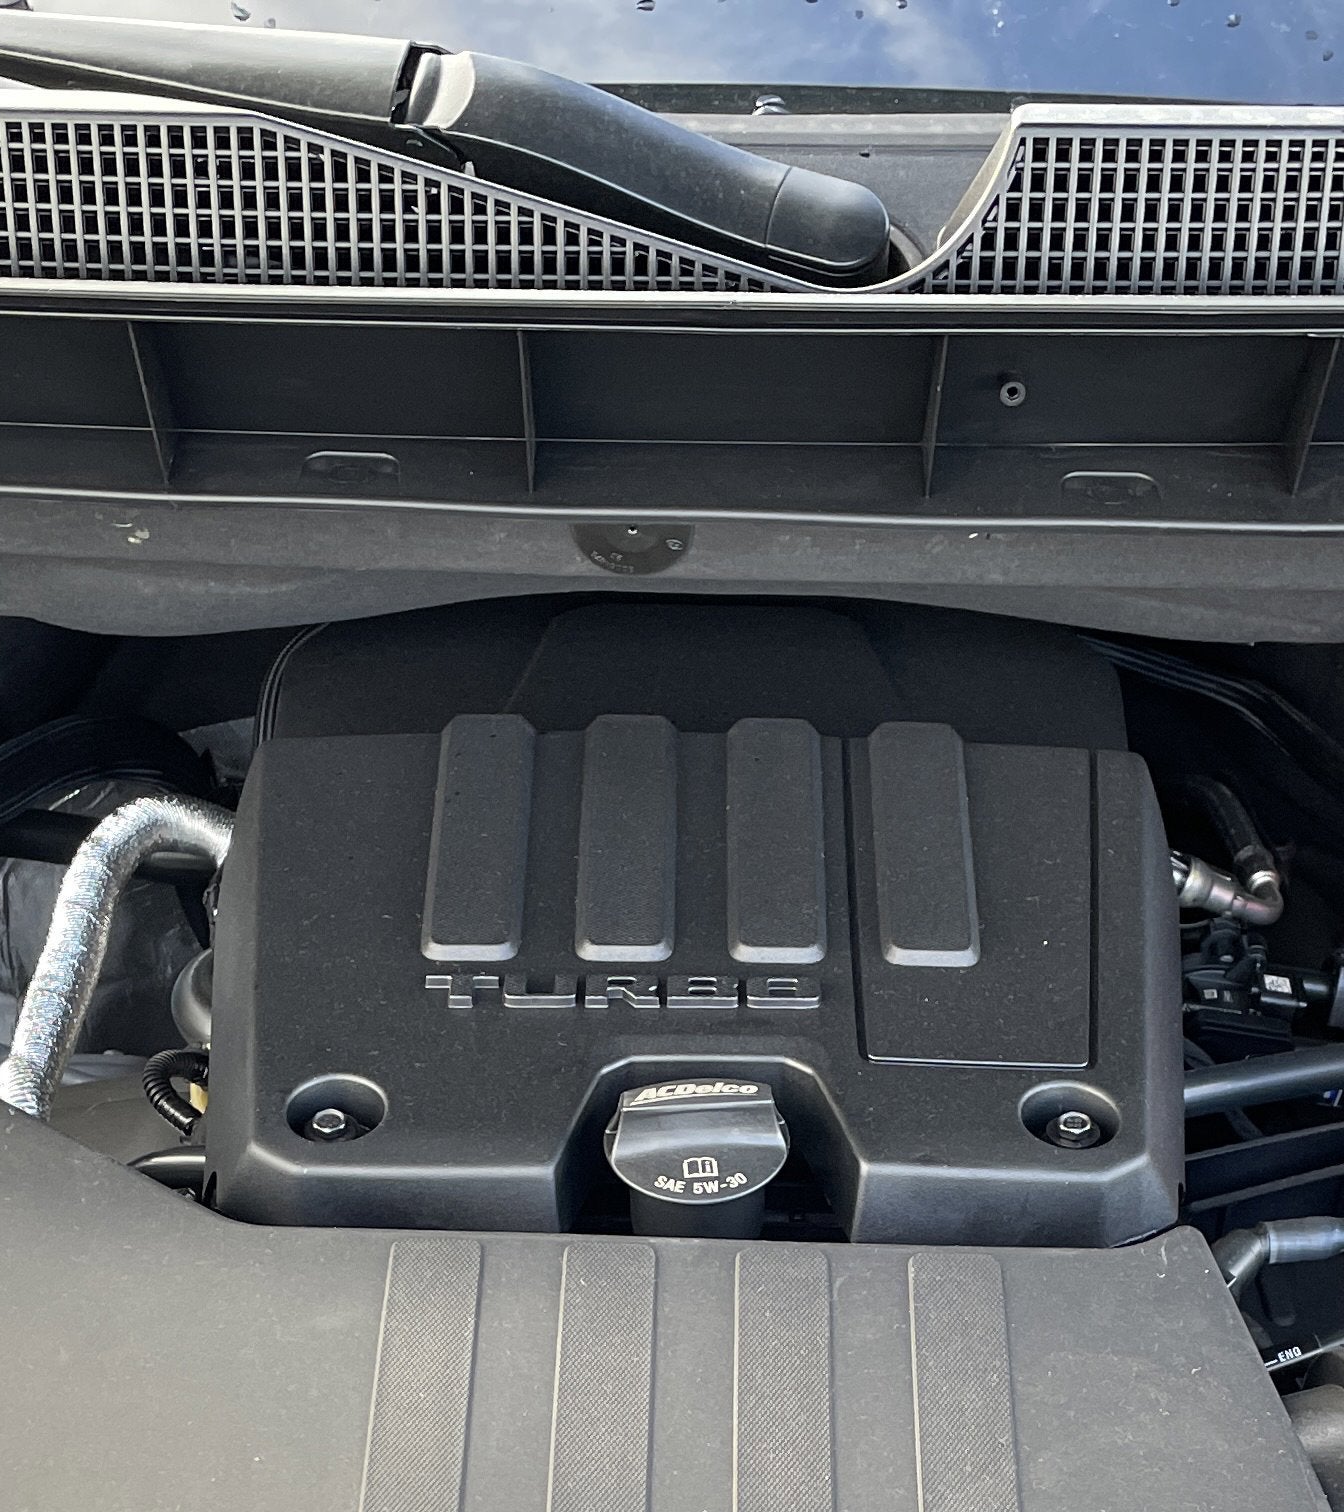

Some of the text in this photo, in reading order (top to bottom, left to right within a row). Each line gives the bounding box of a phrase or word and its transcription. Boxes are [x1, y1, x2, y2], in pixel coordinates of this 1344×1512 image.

[425, 974, 821, 1009] TURBO
[630, 1082, 759, 1106] ACDelco
[654, 1172, 747, 1194] SAE 5W-30
